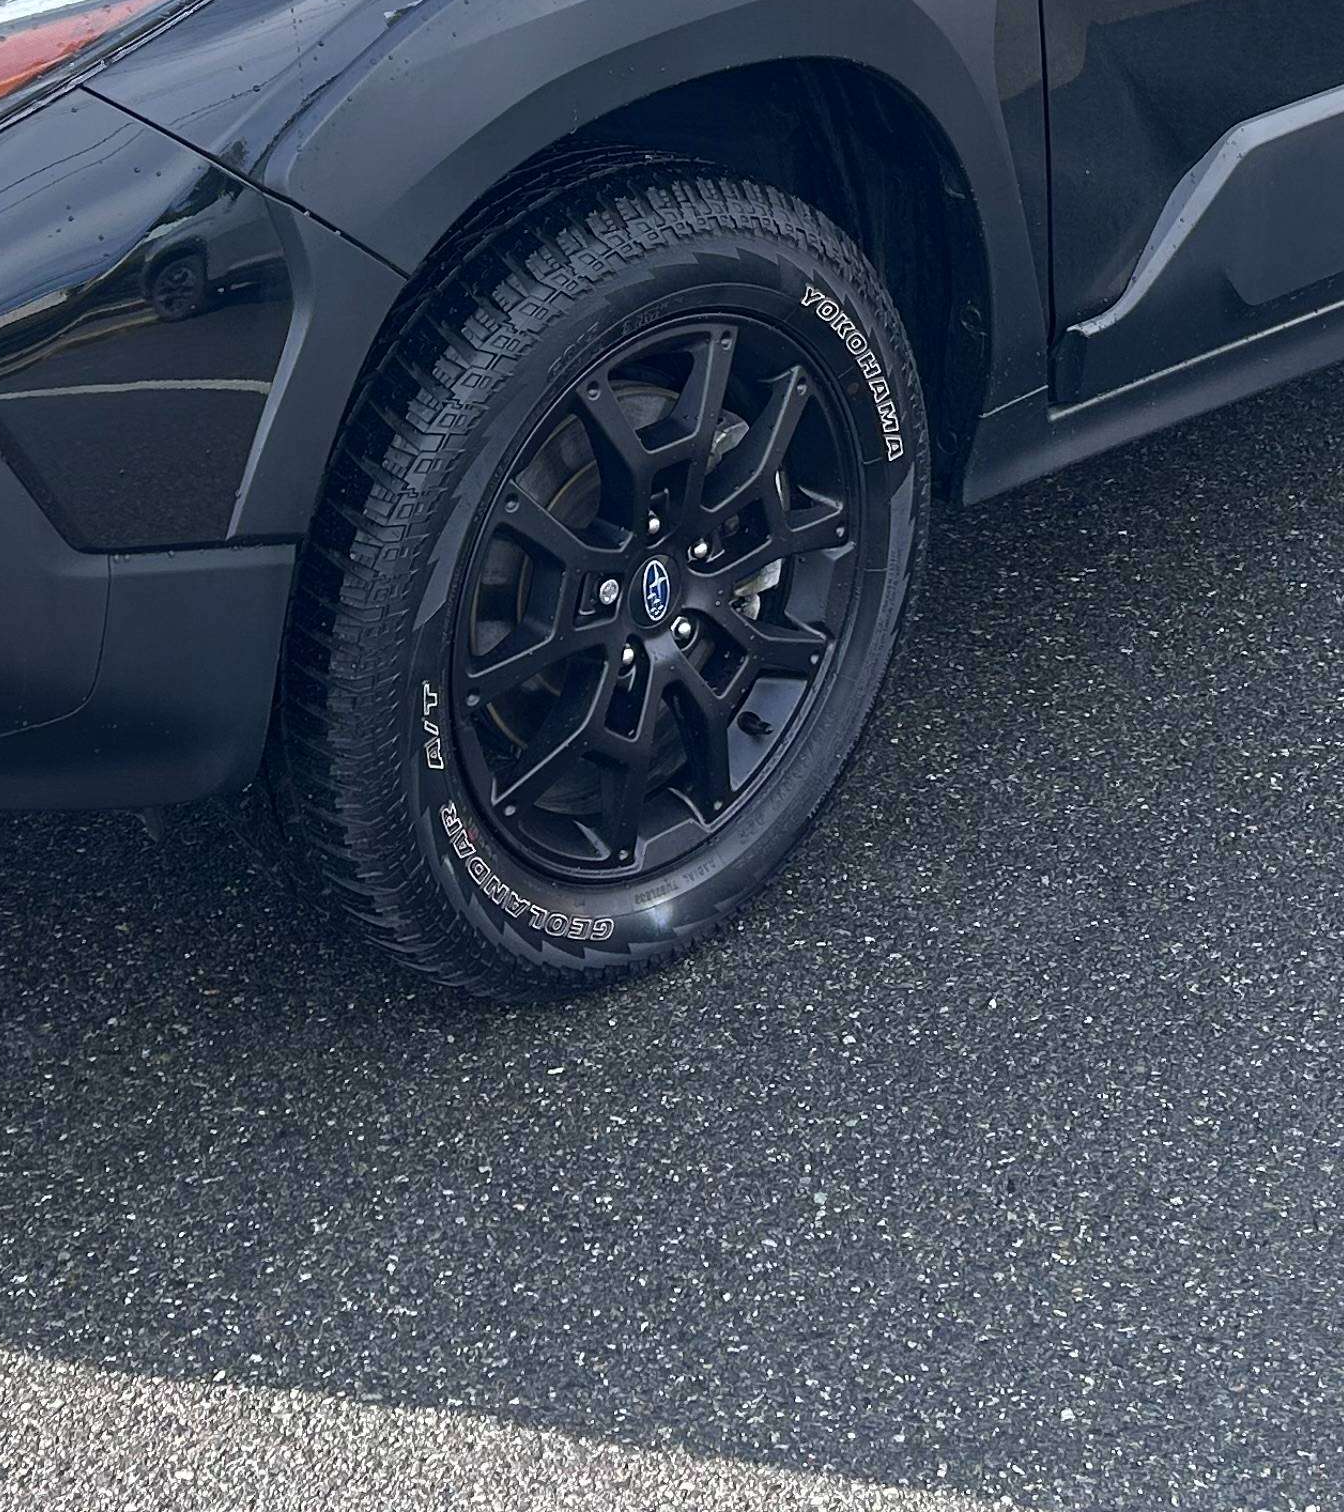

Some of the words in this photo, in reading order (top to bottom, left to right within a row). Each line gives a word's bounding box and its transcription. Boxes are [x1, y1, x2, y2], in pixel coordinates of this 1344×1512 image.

[801, 285, 904, 462] YOKOHAMA
[422, 680, 445, 771] A/T
[440, 800, 615, 942] GEOLANDAR
